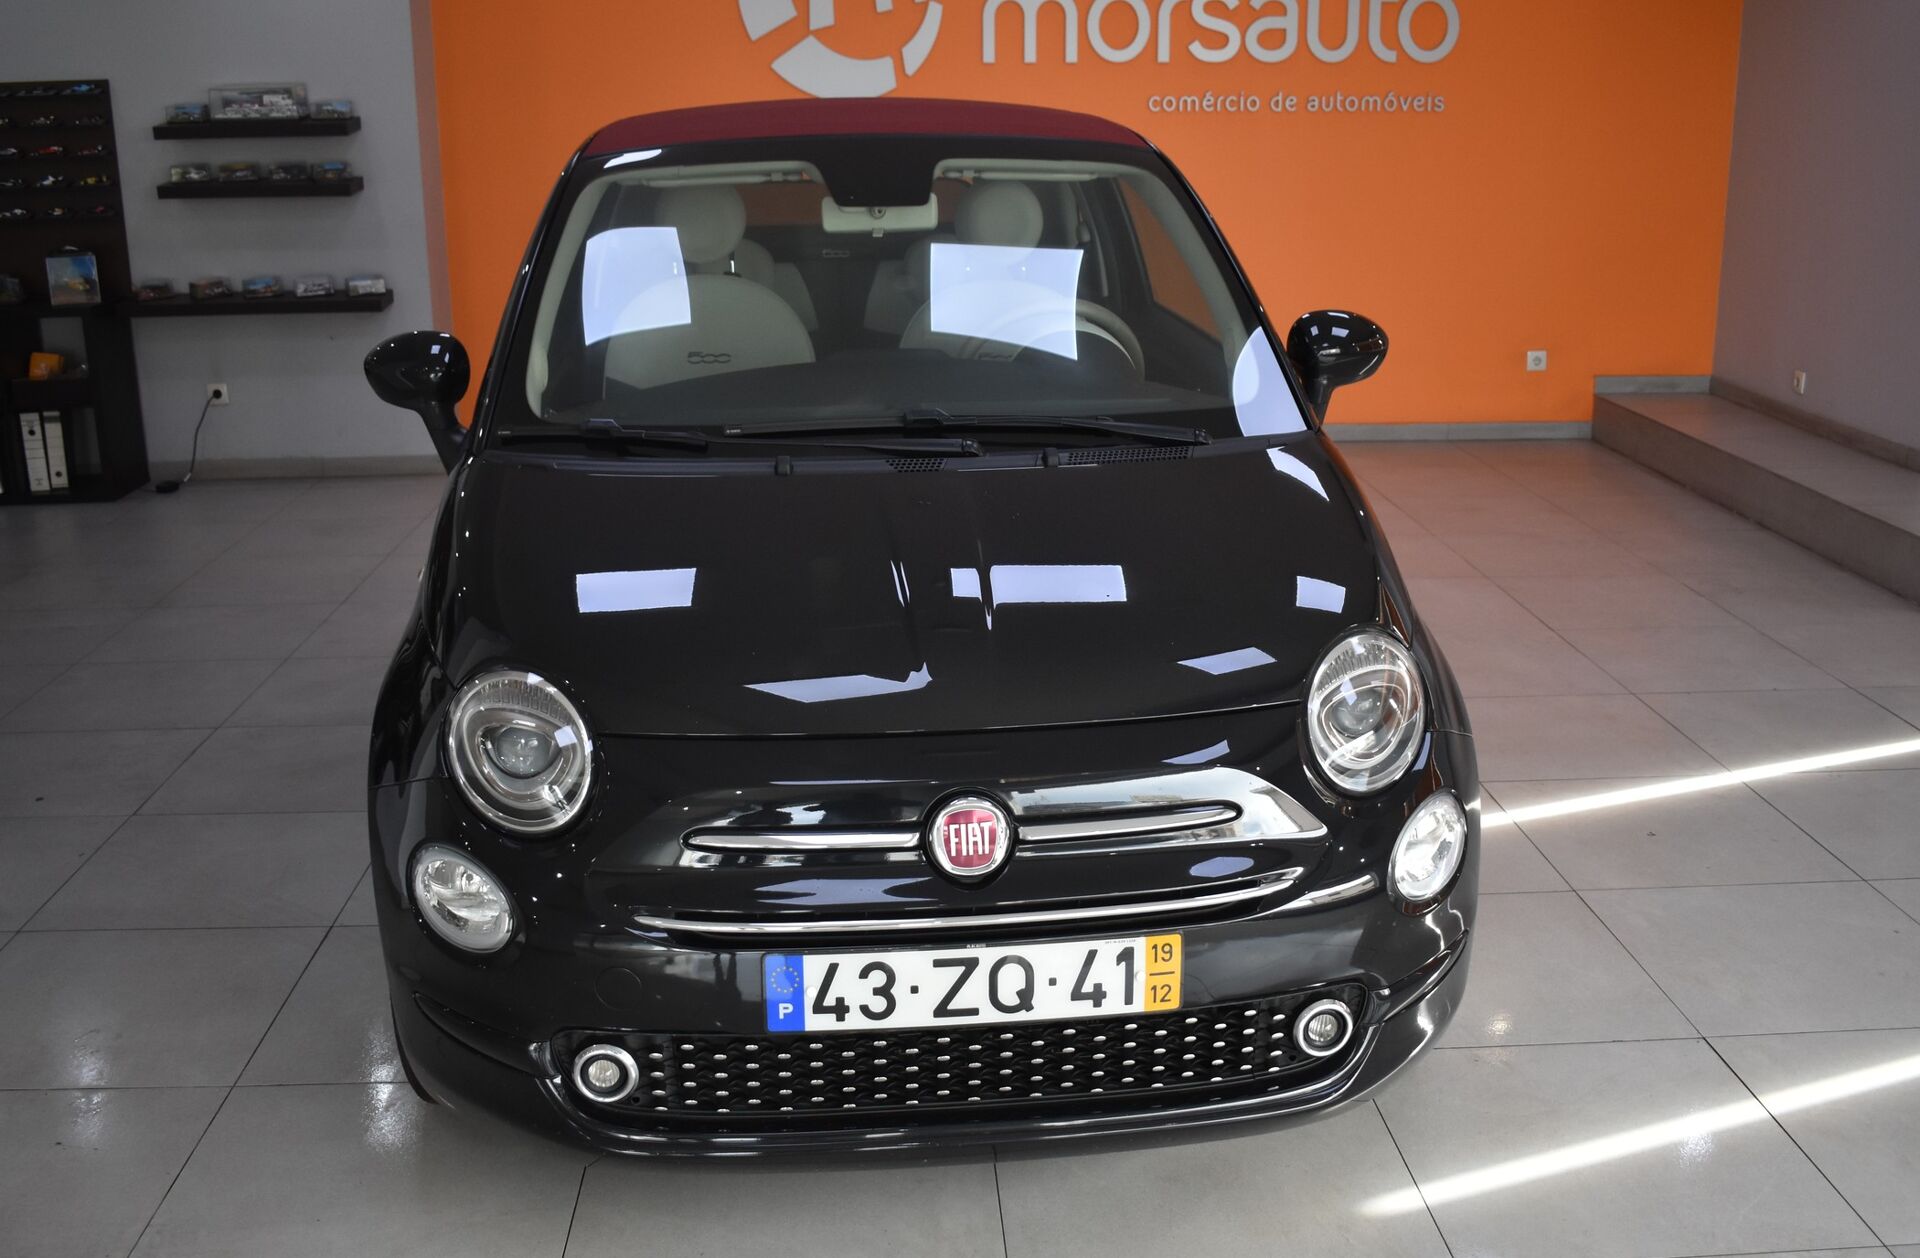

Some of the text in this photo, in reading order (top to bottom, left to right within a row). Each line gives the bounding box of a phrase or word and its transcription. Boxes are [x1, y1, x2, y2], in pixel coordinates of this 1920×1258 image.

[982, 0, 1460, 63] morsauto
[1148, 91, 1446, 112] comércio de automóveis
[949, 821, 993, 857] FIAT
[1151, 943, 1173, 963] 19
[1150, 984, 1172, 1003] 12
[779, 1003, 793, 1020] P
